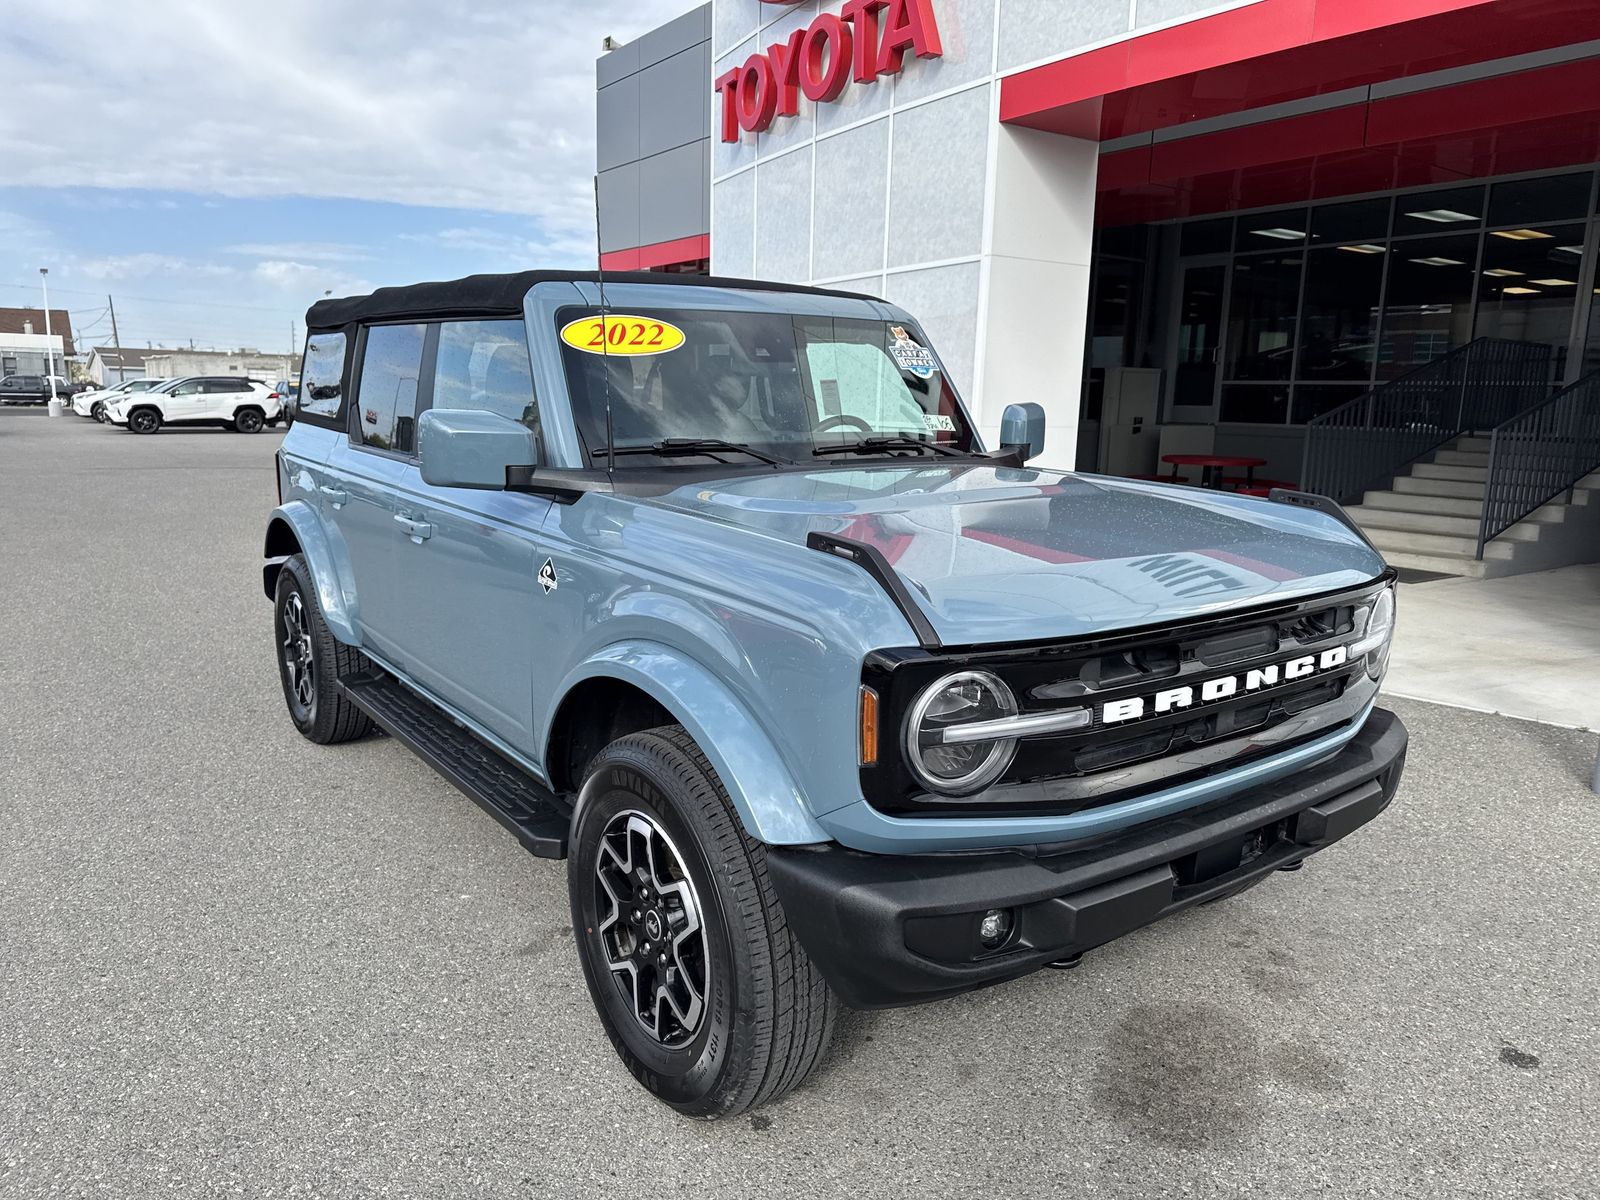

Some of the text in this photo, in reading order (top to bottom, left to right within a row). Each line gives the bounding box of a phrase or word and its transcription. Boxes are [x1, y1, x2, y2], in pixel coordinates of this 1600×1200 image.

[715, 0, 943, 144] TOYOTA
[587, 323, 665, 346] 2022
[1102, 646, 1347, 724] BRONCO
